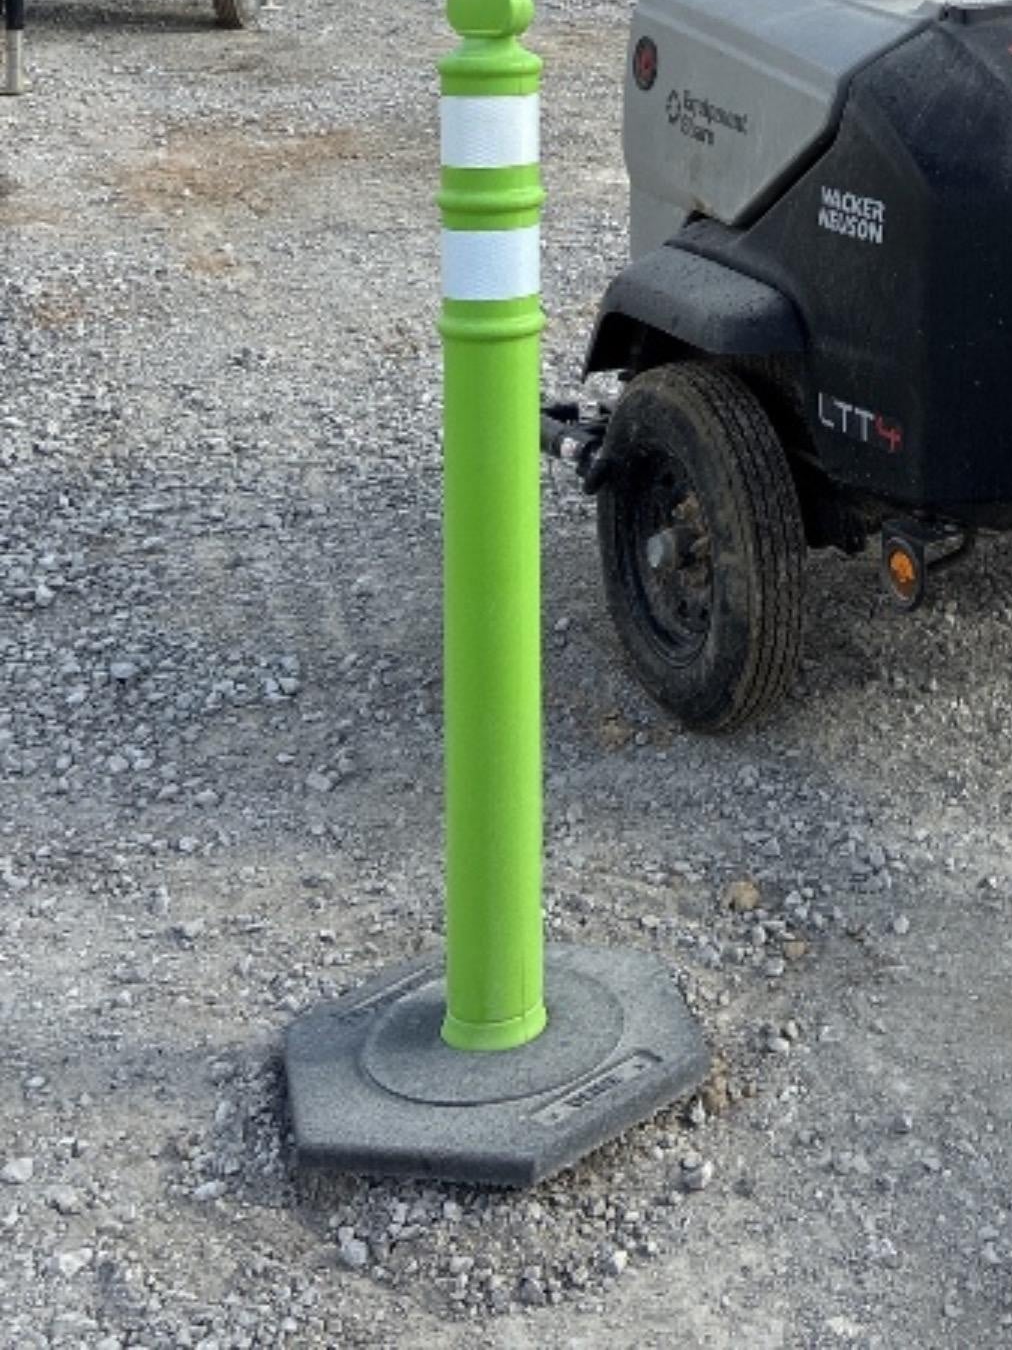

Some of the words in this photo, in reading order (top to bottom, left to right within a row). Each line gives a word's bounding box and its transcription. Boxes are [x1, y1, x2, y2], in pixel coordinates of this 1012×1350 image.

[821, 185, 886, 223] WACKER
[818, 207, 884, 244] NEUSON
[818, 392, 901, 453] LTT4
